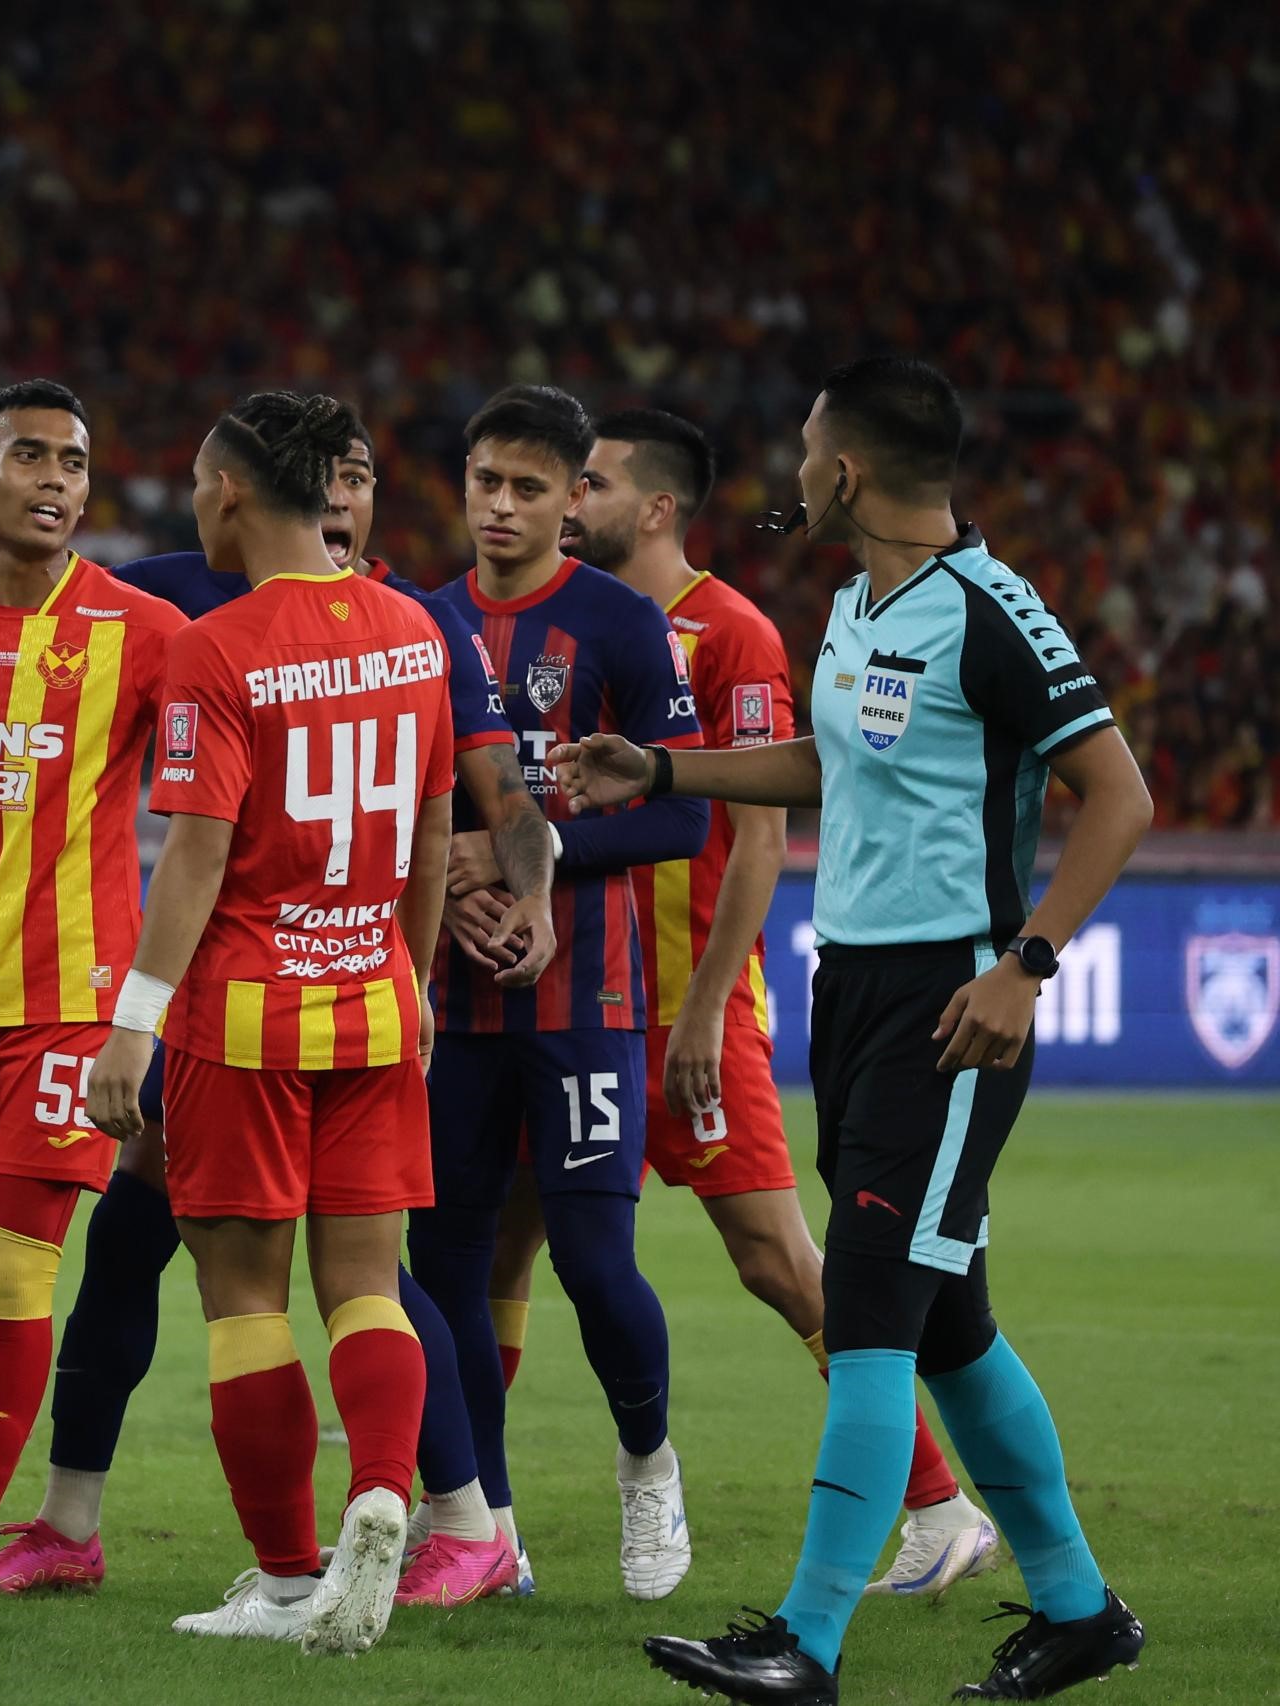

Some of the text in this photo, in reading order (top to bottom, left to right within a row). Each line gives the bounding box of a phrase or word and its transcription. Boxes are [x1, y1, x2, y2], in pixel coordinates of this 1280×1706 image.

[865, 674, 907, 700] FIFA
[861, 705, 905, 723] REFEREE
[869, 733, 889, 745] 2024
[161, 767, 195, 782] MBPJ
[284, 712, 417, 886] 44
[561, 1072, 621, 1143] 15
